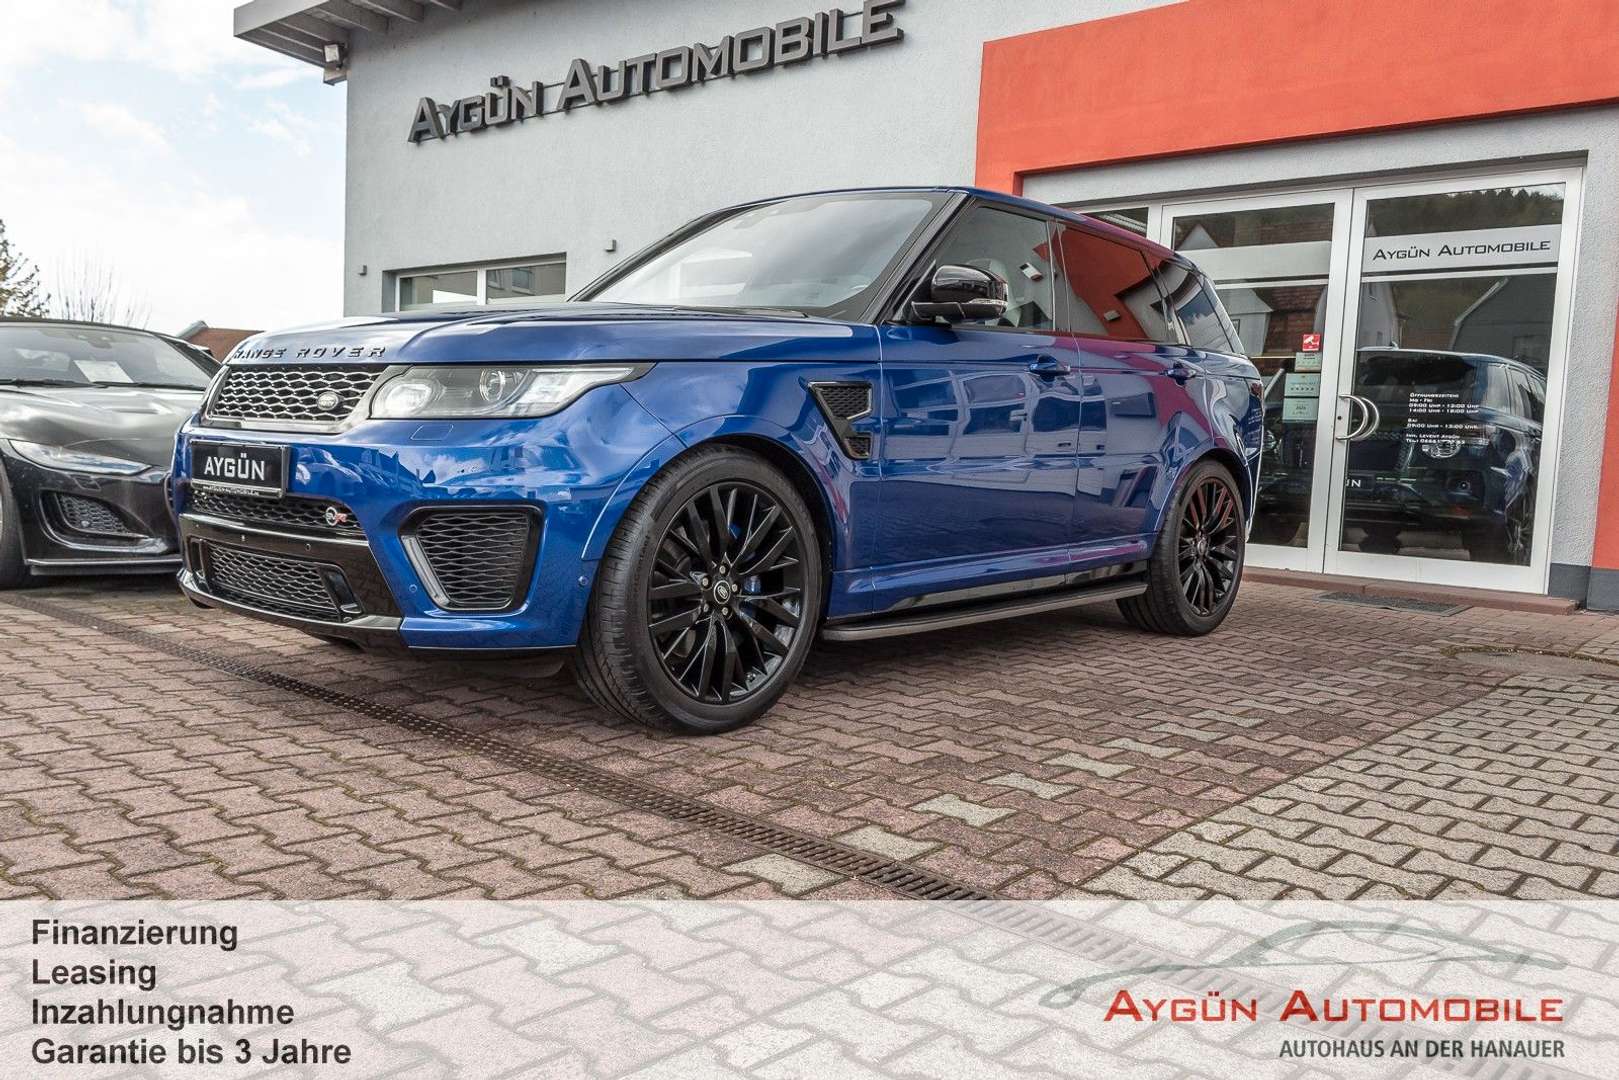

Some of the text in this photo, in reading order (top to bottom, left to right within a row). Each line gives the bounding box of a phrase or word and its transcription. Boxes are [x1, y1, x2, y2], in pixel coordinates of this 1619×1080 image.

[407, 0, 905, 142] AYGÜN AUTOMOBILE
[1372, 240, 1551, 261] AYGÜN AUTOMOBILE
[296, 345, 387, 359] ROVER
[203, 452, 266, 481] AYGÜN
